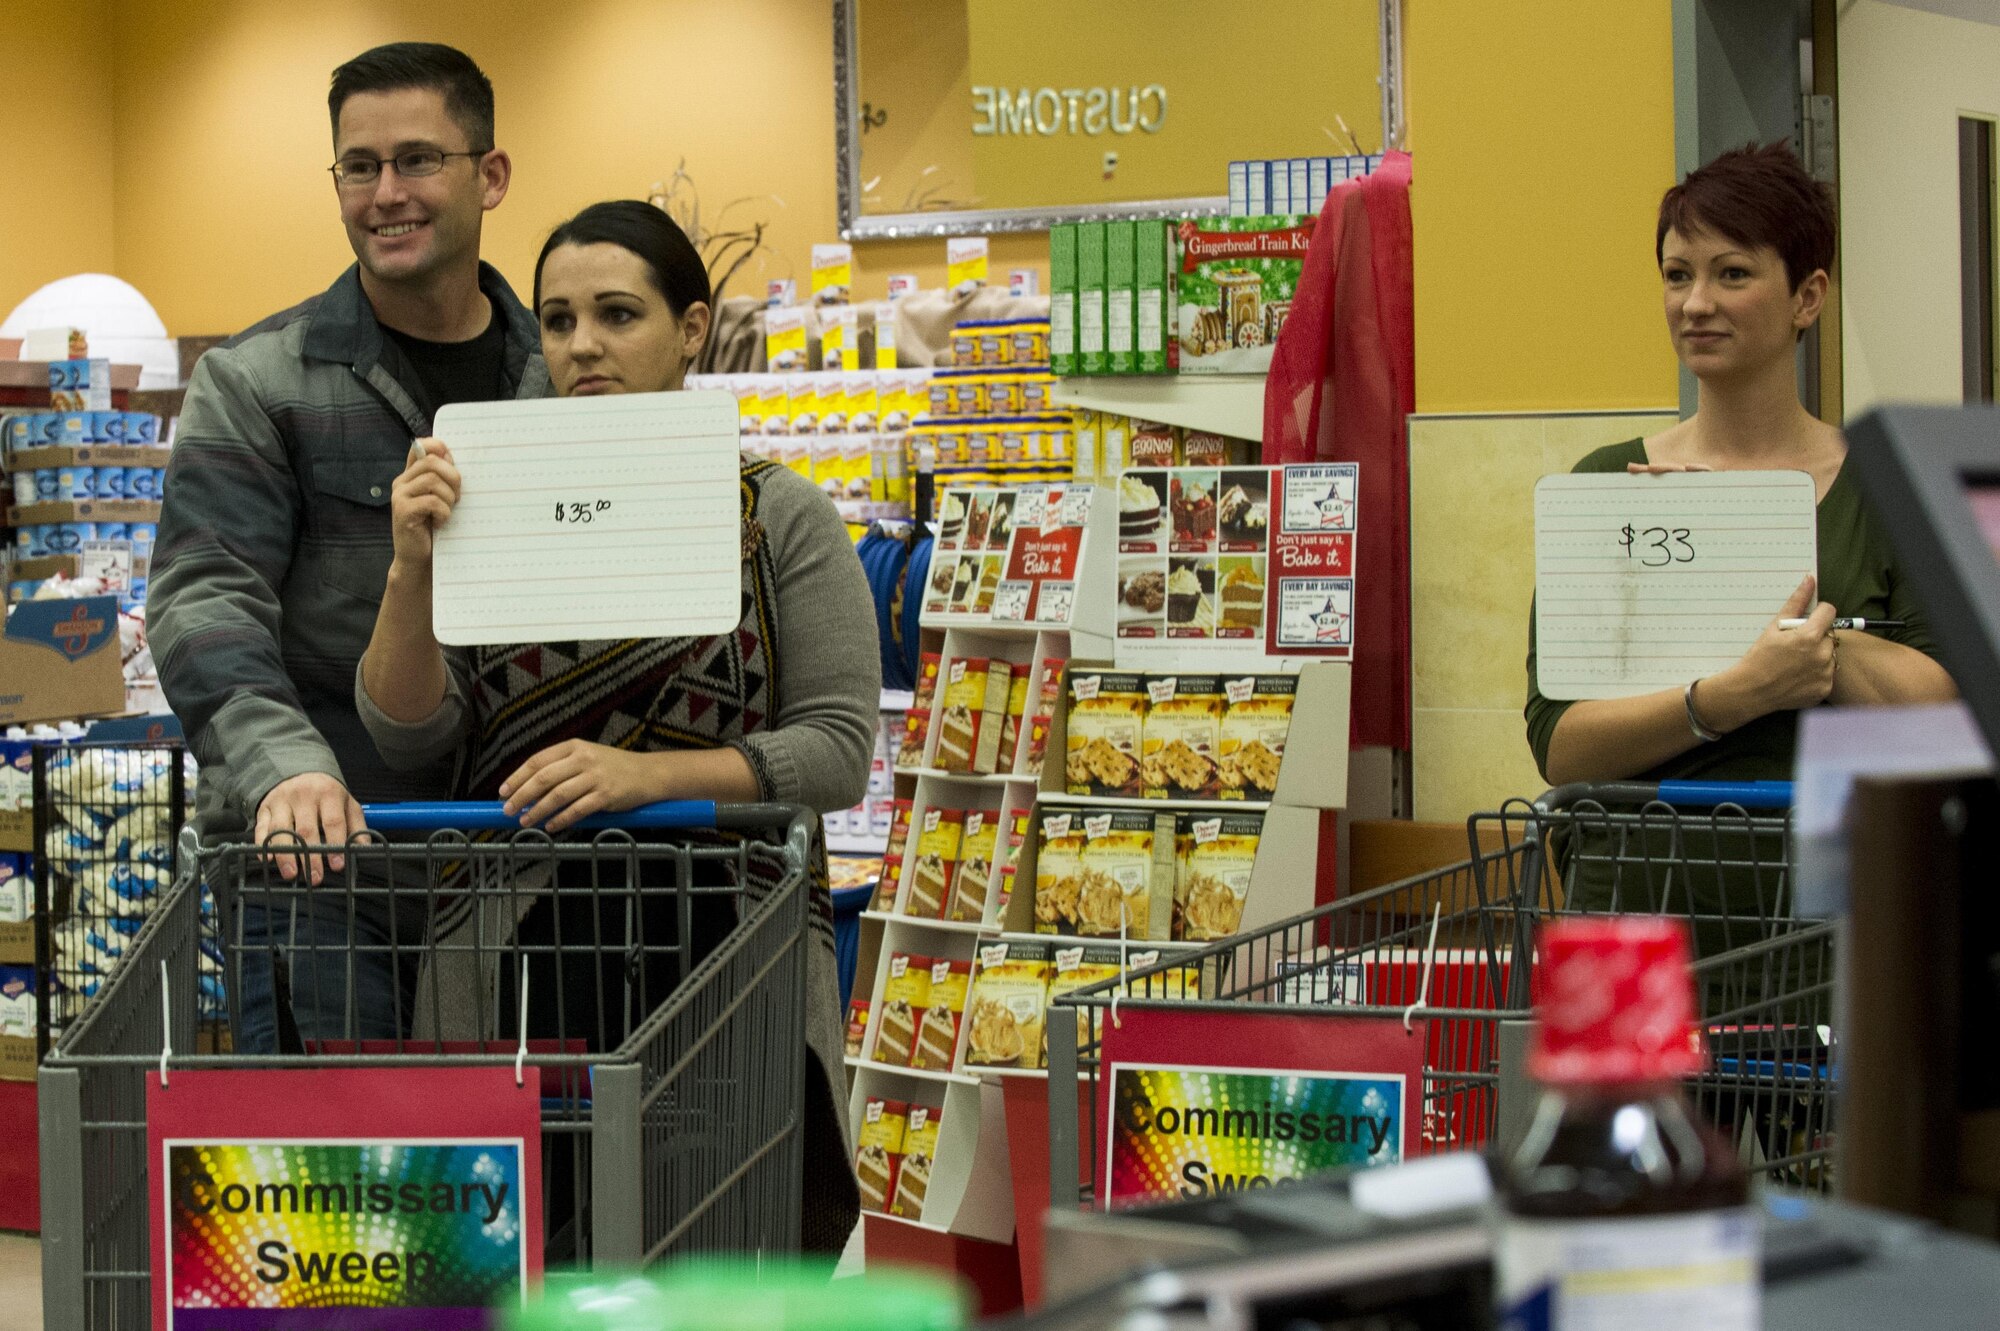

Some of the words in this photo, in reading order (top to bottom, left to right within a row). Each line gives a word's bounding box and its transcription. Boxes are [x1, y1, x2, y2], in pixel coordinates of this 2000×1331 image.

[1189, 236, 1257, 256] Gingerbread
[1258, 234, 1289, 250] Train
[1291, 232, 1310, 249] Kit
[1288, 469, 1308, 479] EVERY
[1310, 469, 1322, 478] DAY
[1325, 468, 1354, 478] SAVINGS
[1276, 534, 1299, 545] Don't
[1300, 534, 1317, 547] just
[1319, 536, 1334, 547] say
[1618, 523, 1695, 567] $33
[1022, 552, 1050, 574] Bake
[1276, 545, 1322, 568] Bake
[1284, 582, 1304, 591] EVERY
[1306, 582, 1319, 591] DAY
[1320, 582, 1350, 591] SAVINGS
[1124, 1098, 1392, 1155] Commissary
[182, 1173, 509, 1224] Commissary
[256, 1240, 436, 1297] Sweep
